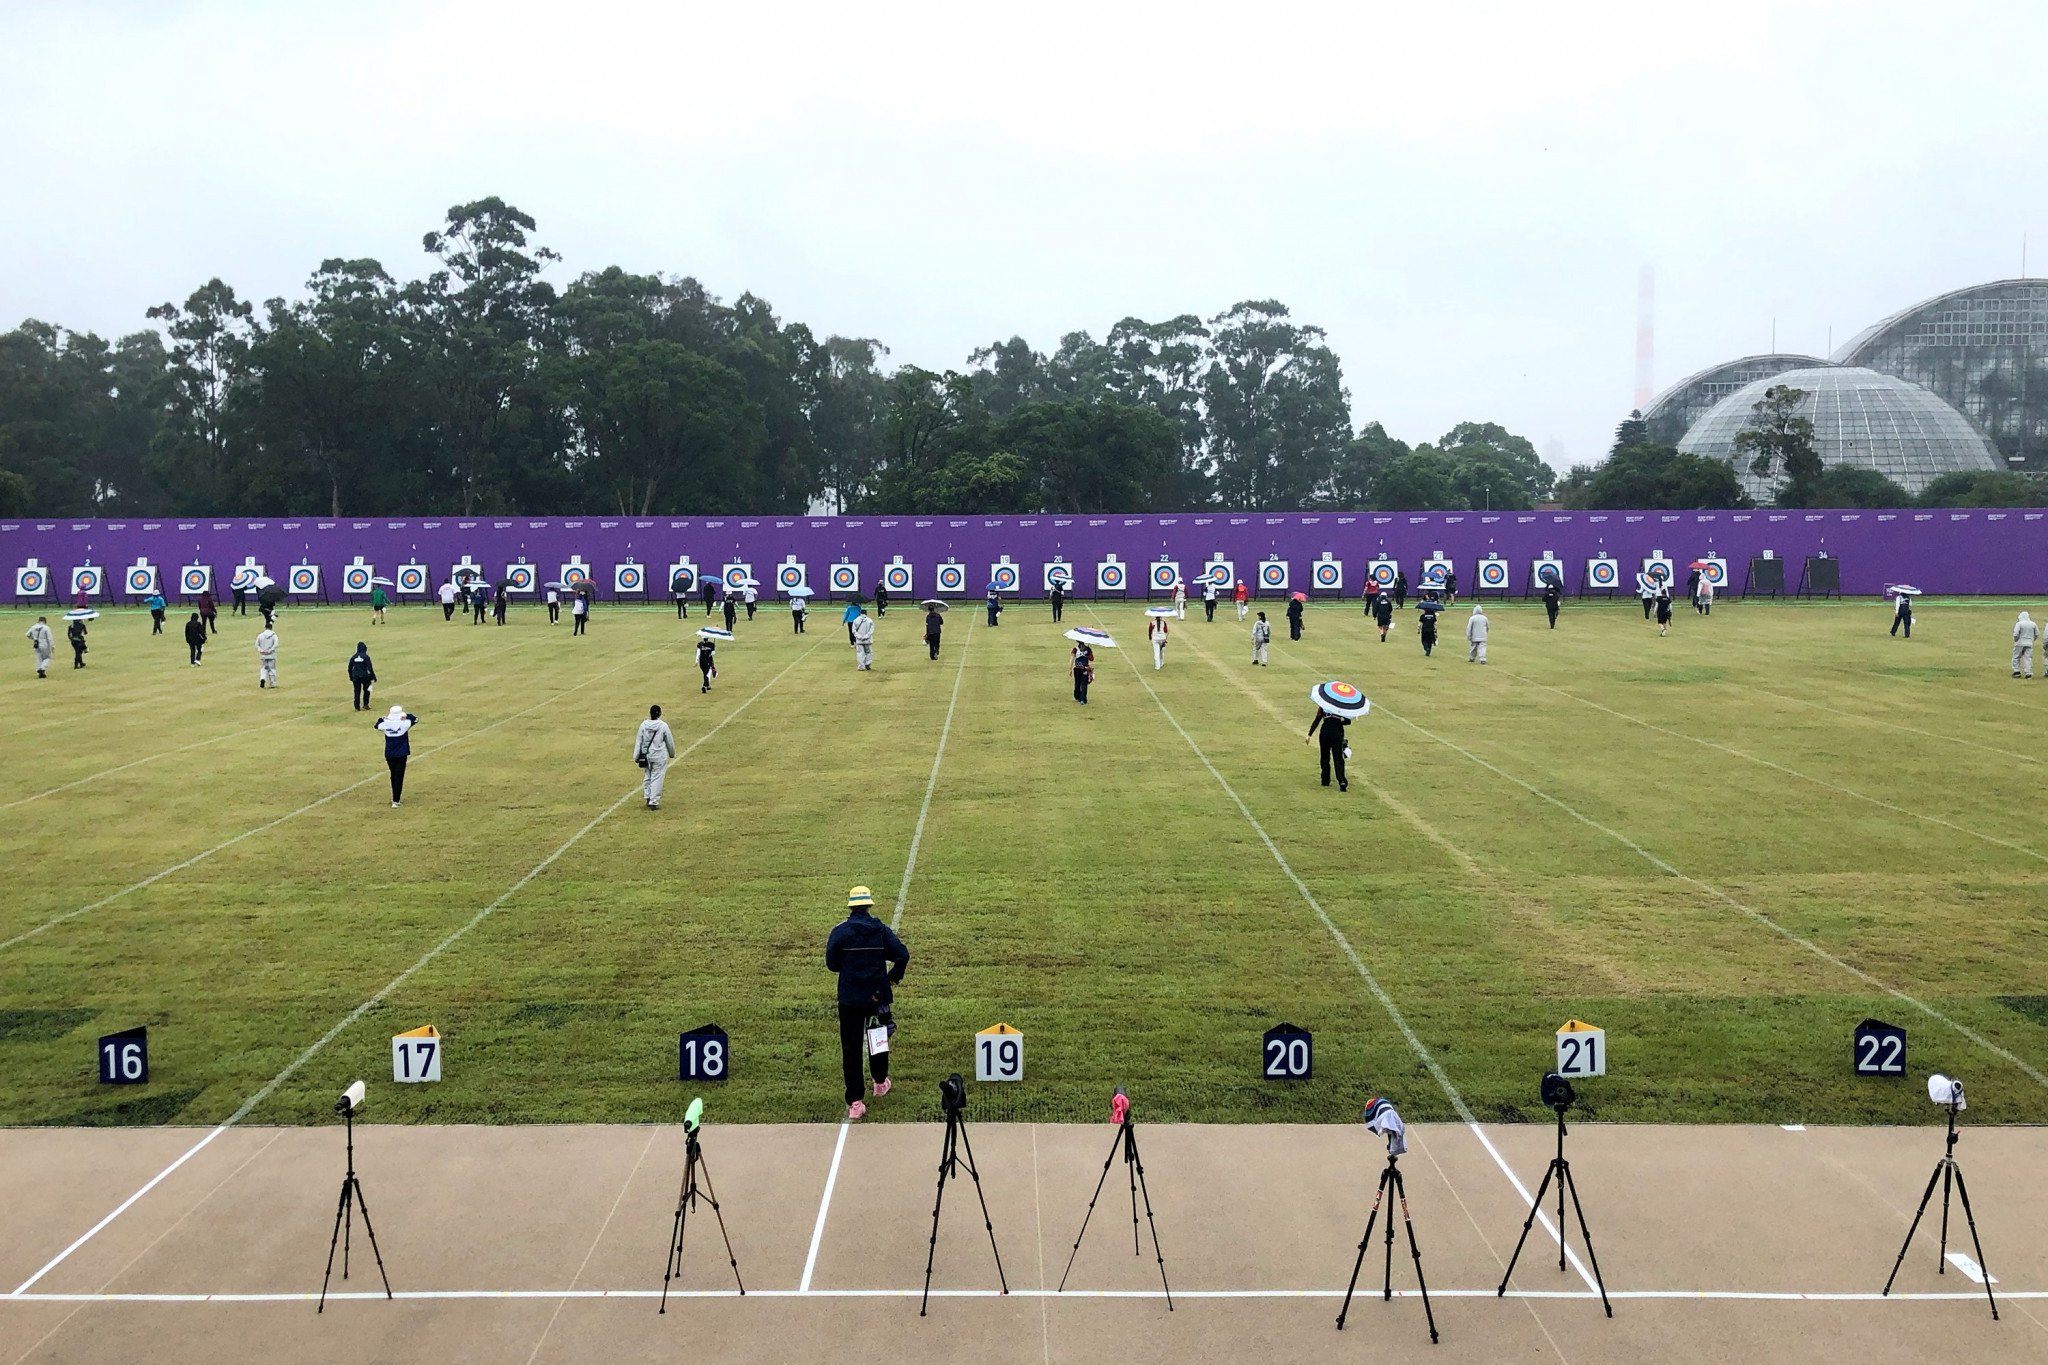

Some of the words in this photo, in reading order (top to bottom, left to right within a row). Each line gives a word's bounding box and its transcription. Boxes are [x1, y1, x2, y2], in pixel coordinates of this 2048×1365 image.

[105, 1044, 141, 1078] 16
[399, 1043, 435, 1077] 17
[686, 1041, 722, 1075] 18
[982, 1041, 1018, 1075] 19
[1267, 1040, 1307, 1074] 20
[1562, 1038, 1595, 1073] 21
[1859, 1036, 1901, 1070] 22
